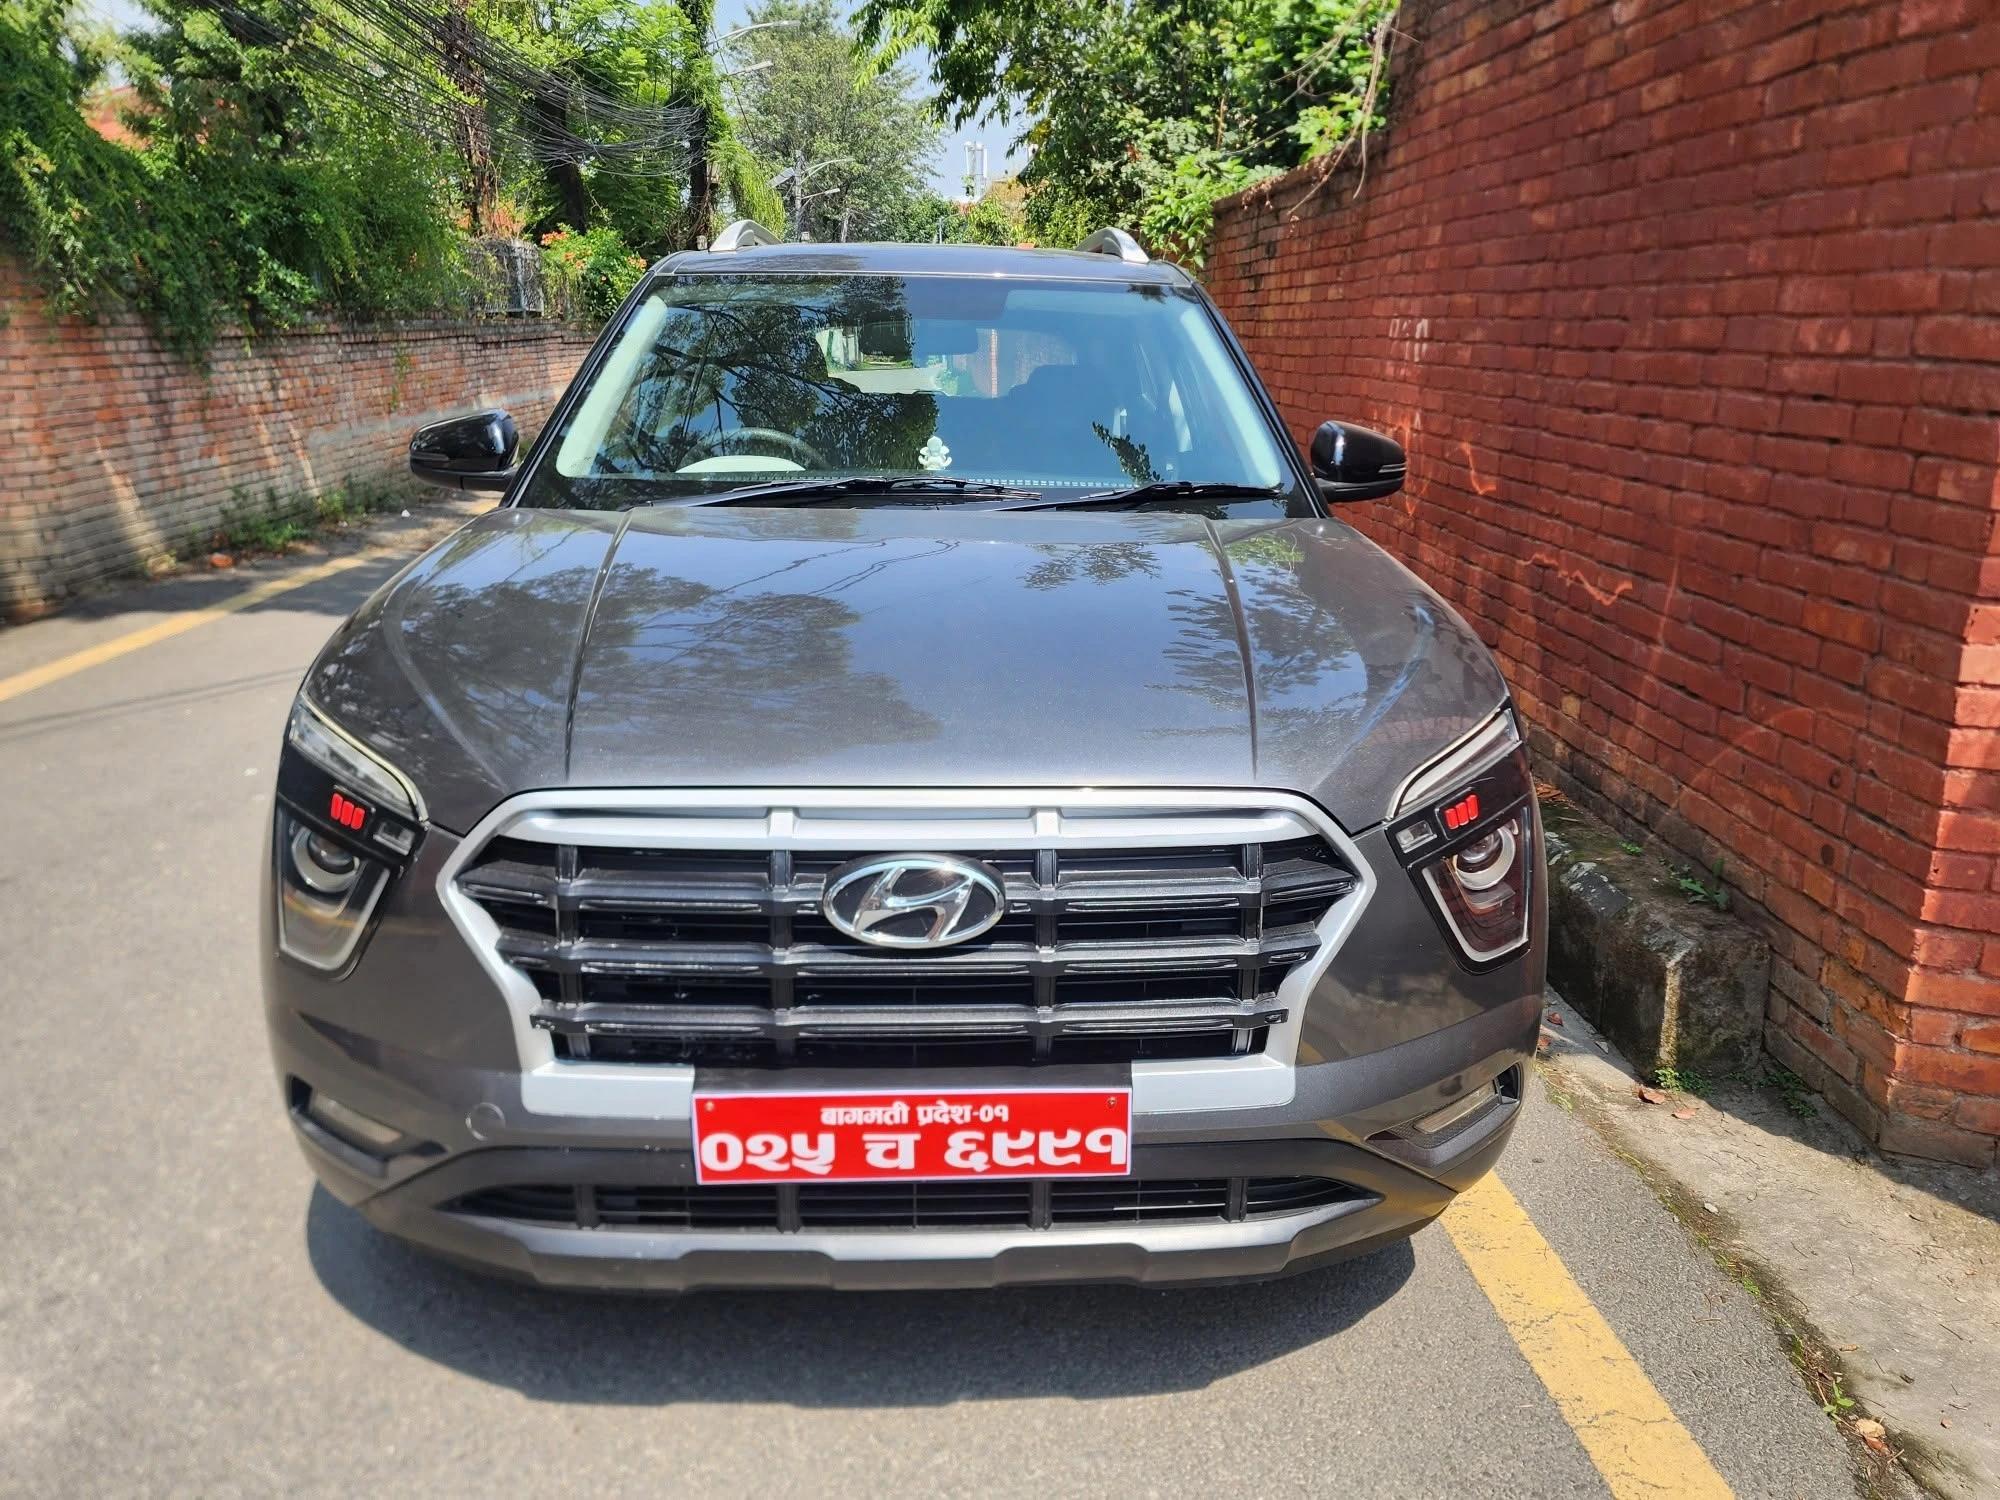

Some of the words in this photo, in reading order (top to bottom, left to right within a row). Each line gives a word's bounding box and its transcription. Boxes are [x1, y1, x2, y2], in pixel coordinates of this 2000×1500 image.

[820, 1100, 910, 1126] बागमती
[916, 1099, 1009, 1126] प्रदेश-०१
[701, 1132, 836, 1175] ०२५
[861, 1132, 921, 1170] च
[943, 1127, 1128, 1172] ६९९१
